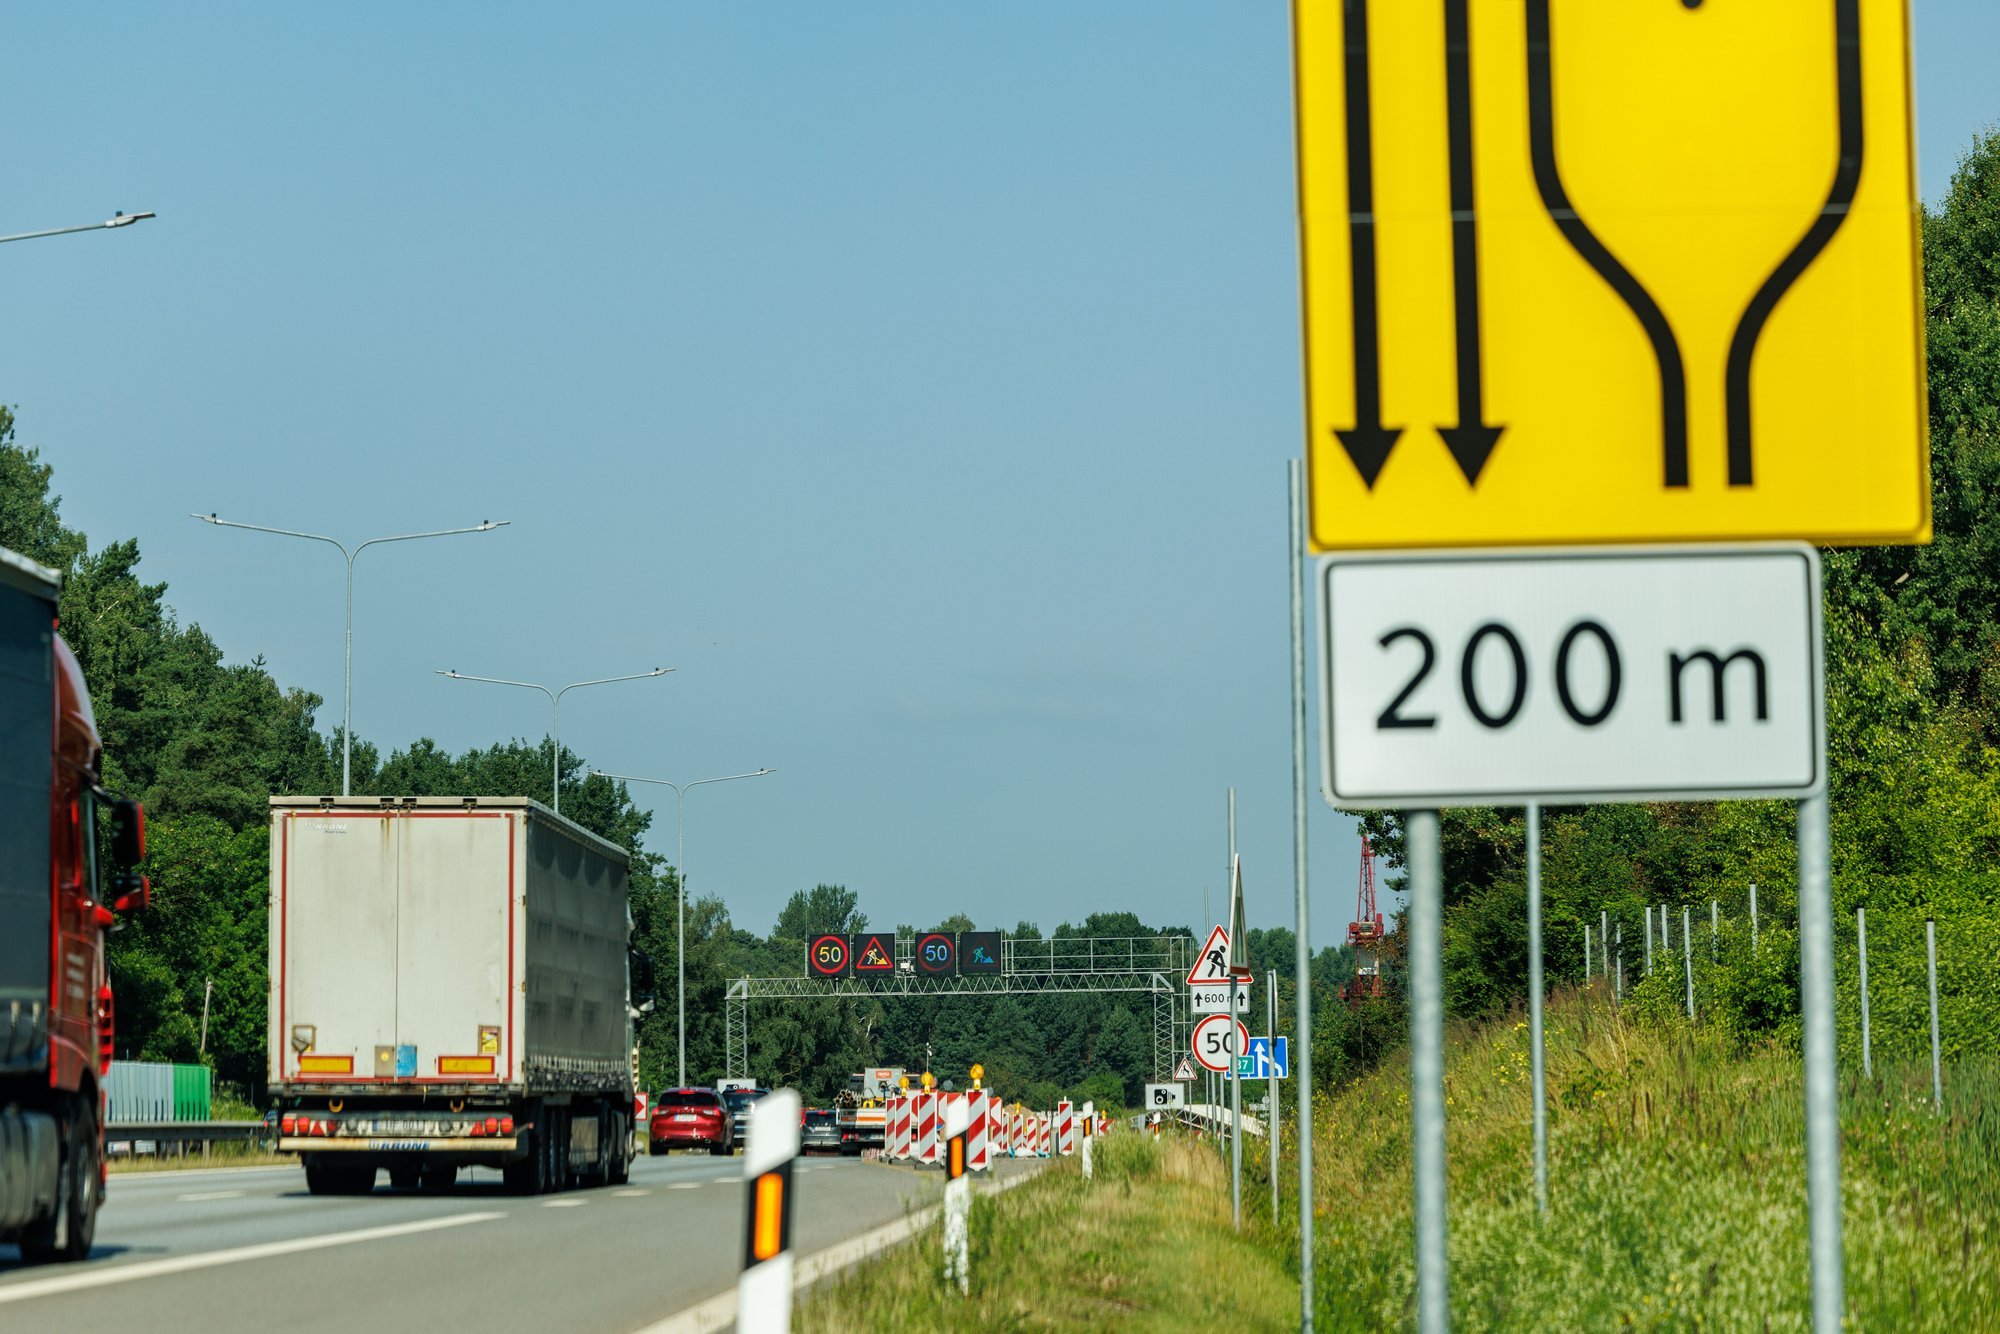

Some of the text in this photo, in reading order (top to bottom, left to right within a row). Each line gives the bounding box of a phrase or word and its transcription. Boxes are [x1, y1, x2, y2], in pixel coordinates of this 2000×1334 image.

[1376, 620, 1768, 729] 200 m
[819, 946, 841, 963] 50
[925, 944, 947, 962] 50
[1204, 993, 1225, 1003] 600
